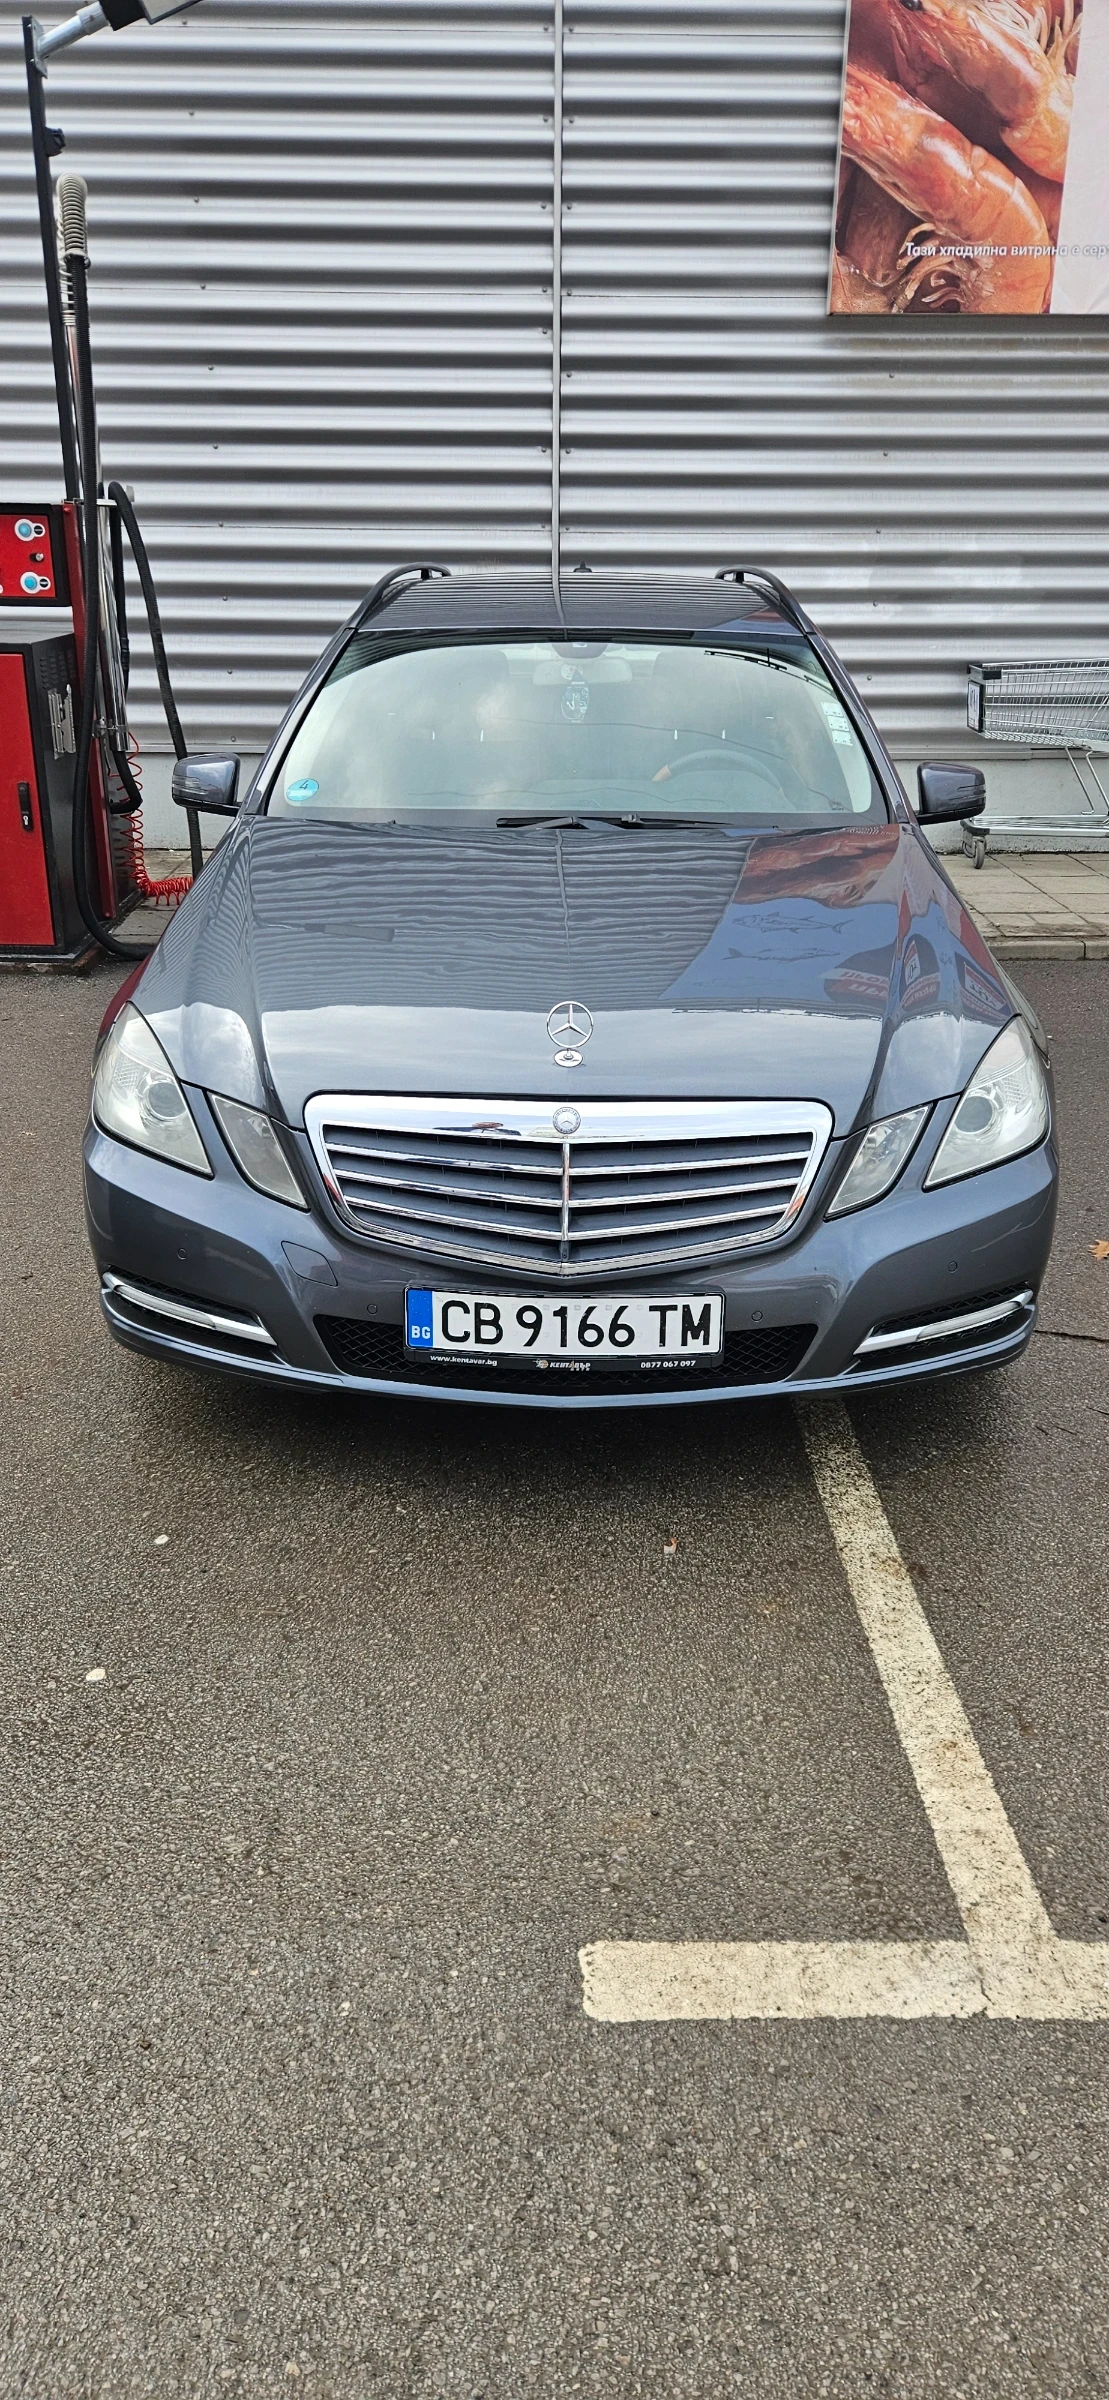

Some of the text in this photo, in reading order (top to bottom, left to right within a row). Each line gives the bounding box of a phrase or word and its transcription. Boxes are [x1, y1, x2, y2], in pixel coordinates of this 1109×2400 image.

[905, 242, 936, 256] Тази
[939, 246, 1007, 259] хладилна
[1011, 246, 1067, 259] витрина
[1072, 246, 1080, 256] е
[411, 1300, 712, 1348] BG CB 9166 TM
[430, 1355, 498, 1367] www.kentavar.bg
[640, 1361, 662, 1369] 0877
